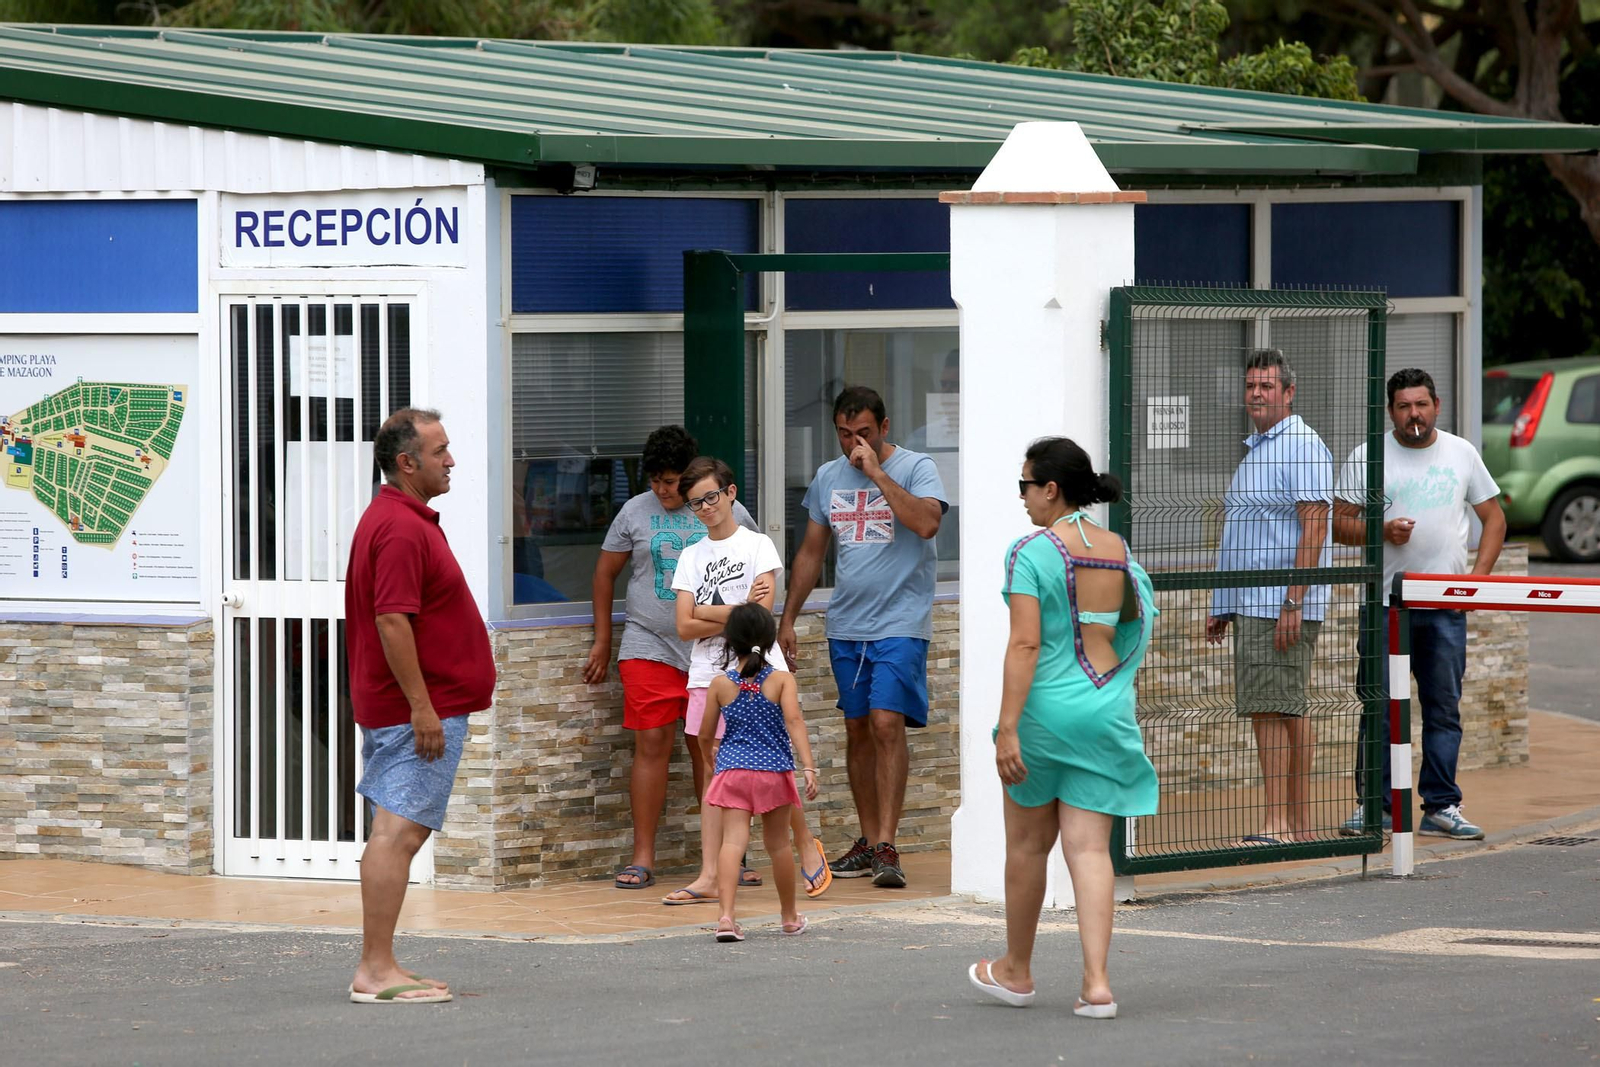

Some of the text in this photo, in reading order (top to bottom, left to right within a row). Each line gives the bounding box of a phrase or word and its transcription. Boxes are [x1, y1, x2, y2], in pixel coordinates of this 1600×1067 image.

[235, 198, 459, 248] RECEPCIÓN
[29, 354, 57, 365] PLAYA
[7, 366, 52, 378] MAZAGON
[1153, 407, 1175, 415] PRENSA
[1151, 422, 1158, 430] EL
[650, 514, 708, 530] HARLE
[650, 531, 709, 600] 6
[704, 556, 730, 582] San
